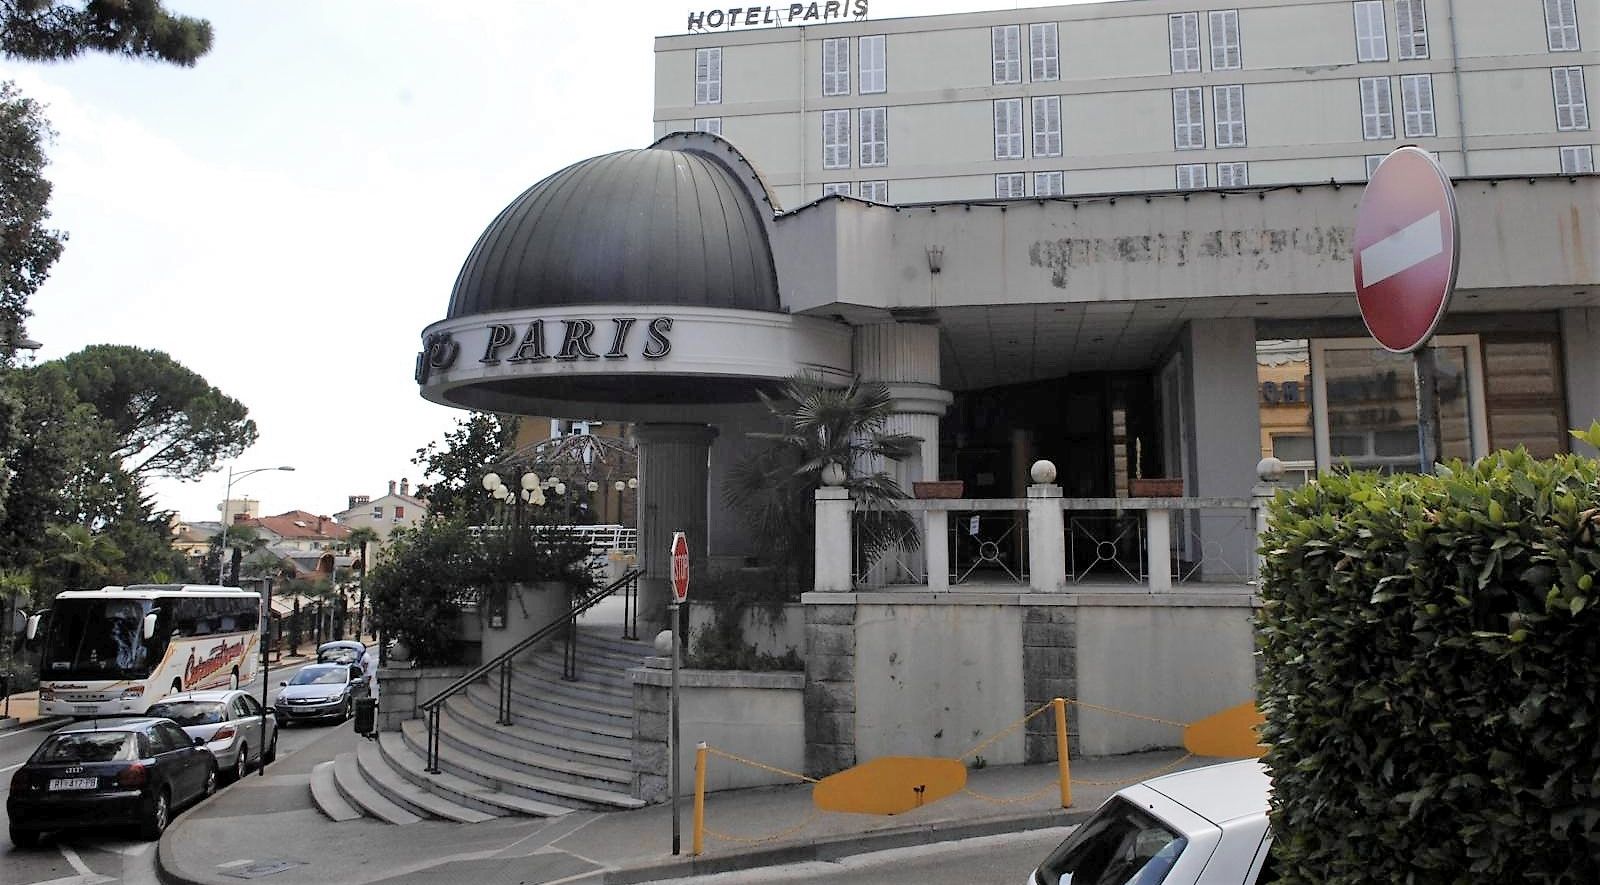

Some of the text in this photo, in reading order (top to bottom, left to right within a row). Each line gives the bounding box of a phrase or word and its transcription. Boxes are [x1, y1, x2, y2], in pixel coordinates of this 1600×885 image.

[687, 0, 868, 30] HOTEL PARIS
[479, 317, 674, 365] PARIS
